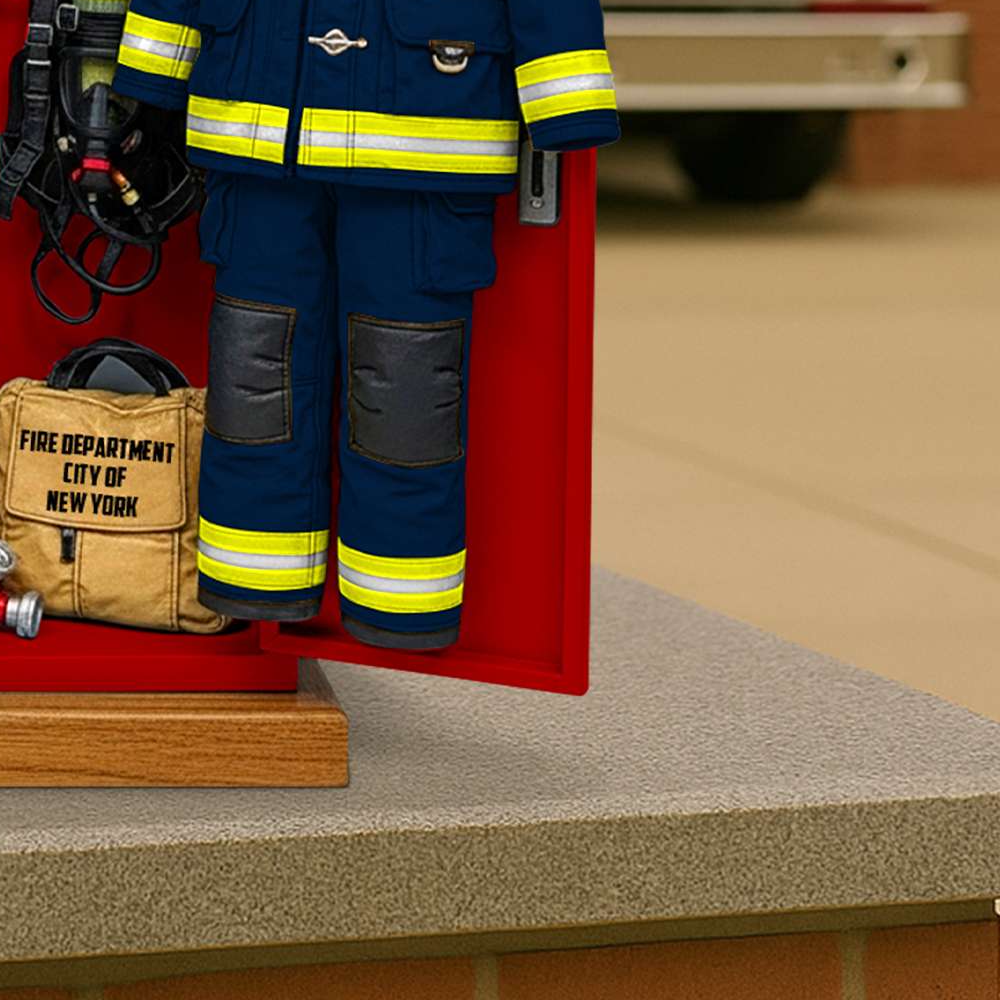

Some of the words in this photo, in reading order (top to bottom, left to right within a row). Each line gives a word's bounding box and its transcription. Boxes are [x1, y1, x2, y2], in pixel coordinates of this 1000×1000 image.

[20, 429, 58, 453] FIRE
[61, 433, 175, 463] DEPARTMENT
[63, 462, 101, 487] CITY
[104, 466, 127, 487] OF
[46, 490, 87, 513] NEW
[91, 494, 139, 517] YORK
